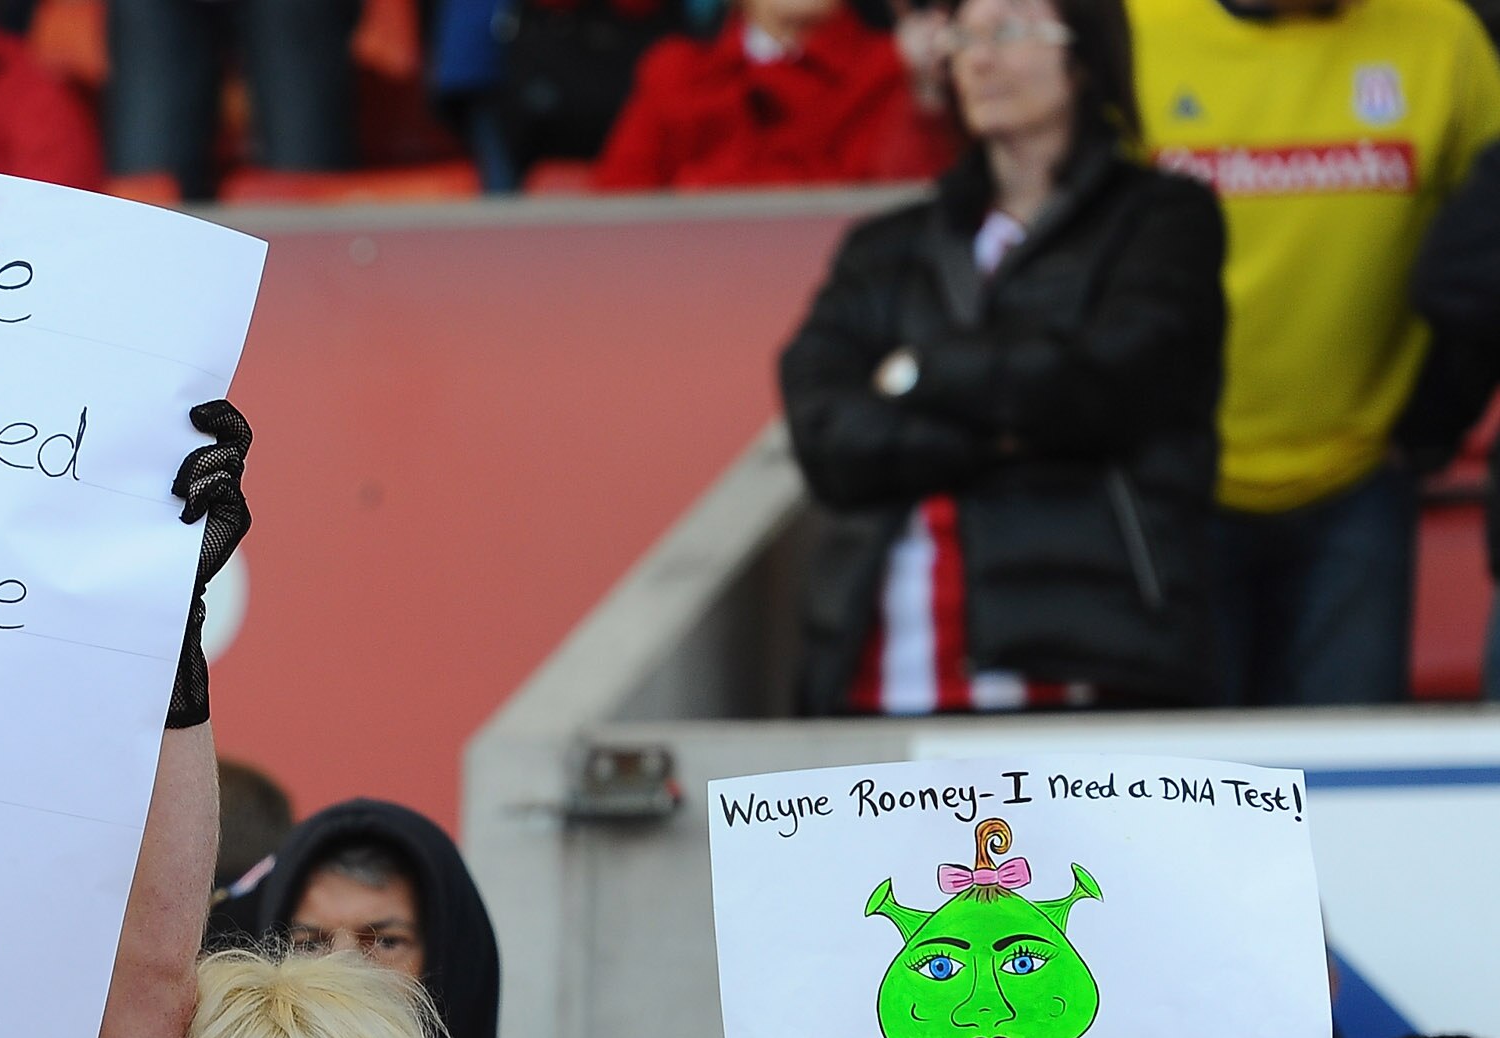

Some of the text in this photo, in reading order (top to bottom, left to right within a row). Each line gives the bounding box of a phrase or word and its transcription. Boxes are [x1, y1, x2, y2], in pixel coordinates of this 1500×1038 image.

[719, 792, 834, 838] Wayne
[1128, 779, 1153, 799] a
[1158, 776, 1216, 807] DNA
[1220, 779, 1303, 823] Test!
